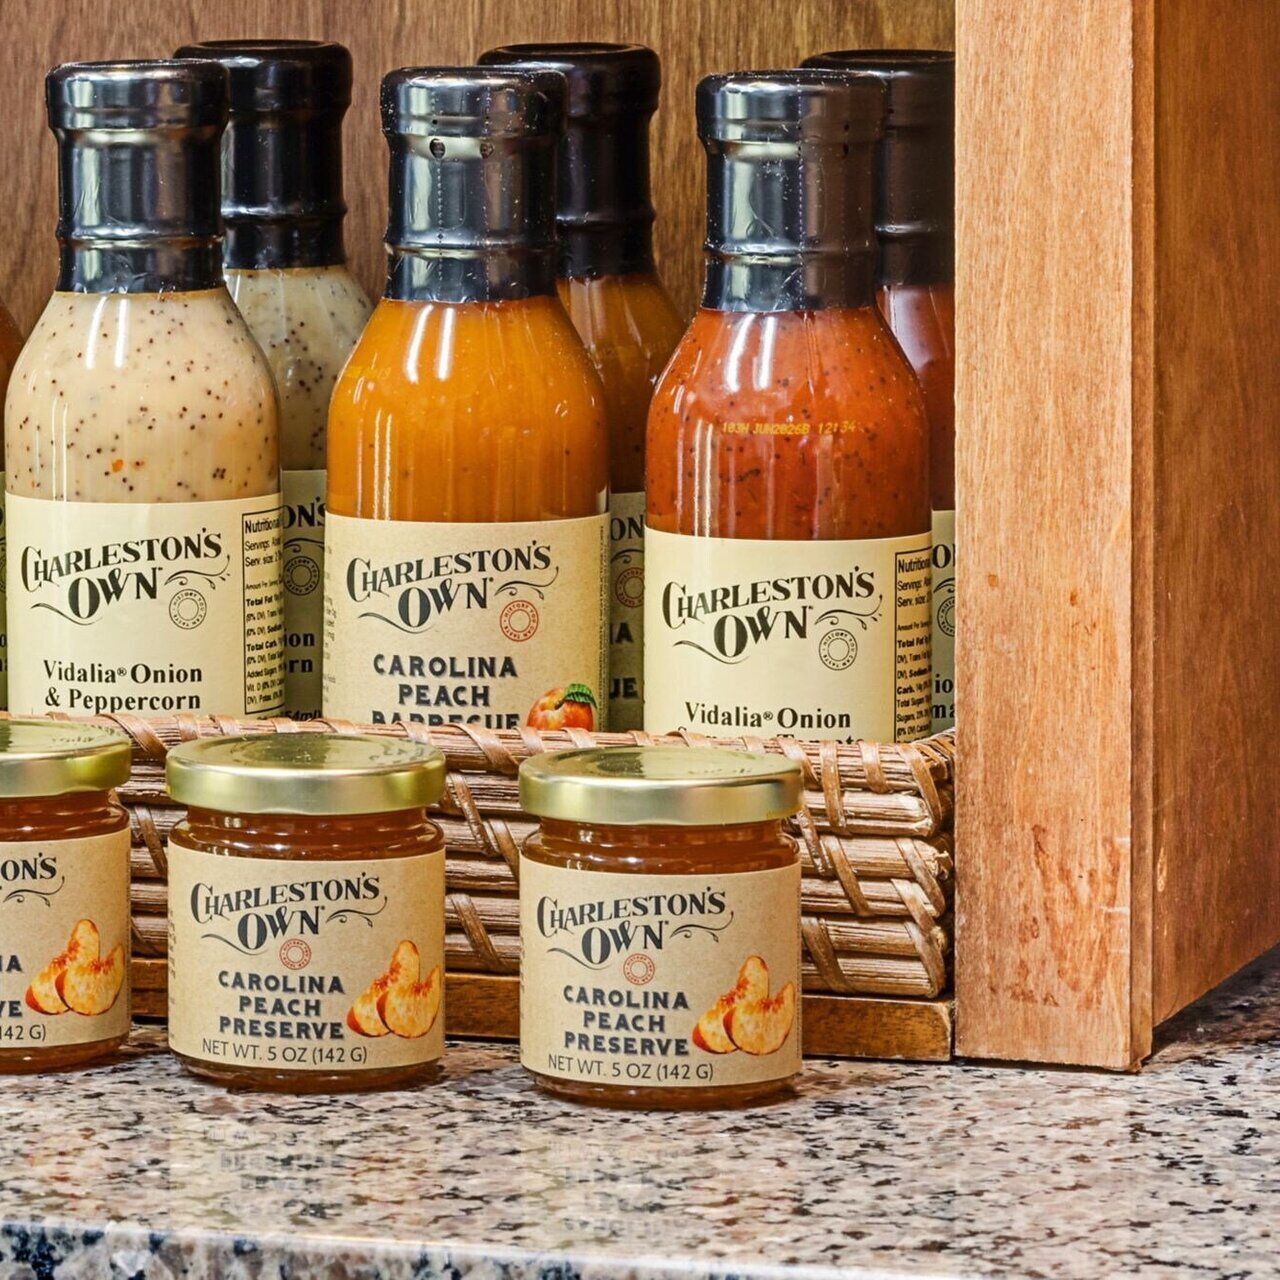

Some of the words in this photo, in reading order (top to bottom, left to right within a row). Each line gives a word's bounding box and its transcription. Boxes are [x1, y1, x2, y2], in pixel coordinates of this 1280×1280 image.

[21, 527, 222, 593] CHARLESTON'S
[346, 540, 551, 602] CHARLESTON'S
[68, 567, 158, 619] OWN
[398, 578, 488, 628] OWN
[662, 566, 875, 630] CHARLESTON'S
[713, 606, 808, 658] OWN
[131, 663, 202, 683] Onion
[373, 654, 518, 678] CAROLINA
[45, 690, 61, 707] &
[69, 689, 201, 714] Peppercorn
[399, 684, 490, 706] PEACH
[777, 707, 851, 728] Onion
[191, 872, 380, 924] CHARLESTON'S
[537, 886, 726, 938] CHARLESTON'S
[238, 906, 320, 950] OWN
[582, 920, 663, 964] OWN
[218, 970, 345, 994] CAROLINA
[239, 995, 321, 1017] PEACH
[563, 985, 689, 1010] CAROLINA
[29, 1023, 46, 1042] G)
[219, 1016, 344, 1039] PRESERVE
[584, 1010, 666, 1032] PEACH
[202, 1038, 227, 1056] NET
[232, 1043, 262, 1060] WT.
[267, 1046, 276, 1061] 5
[282, 1047, 307, 1062] OZ
[312, 1046, 345, 1065] (142
[350, 1046, 367, 1064] G)
[565, 1031, 689, 1056] PRESERVE
[548, 1053, 573, 1070] NET
[577, 1059, 606, 1077] WT.
[612, 1063, 620, 1078] 5
[626, 1063, 652, 1079] OZ
[657, 1063, 690, 1082] (142
[696, 1062, 714, 1081] G)
